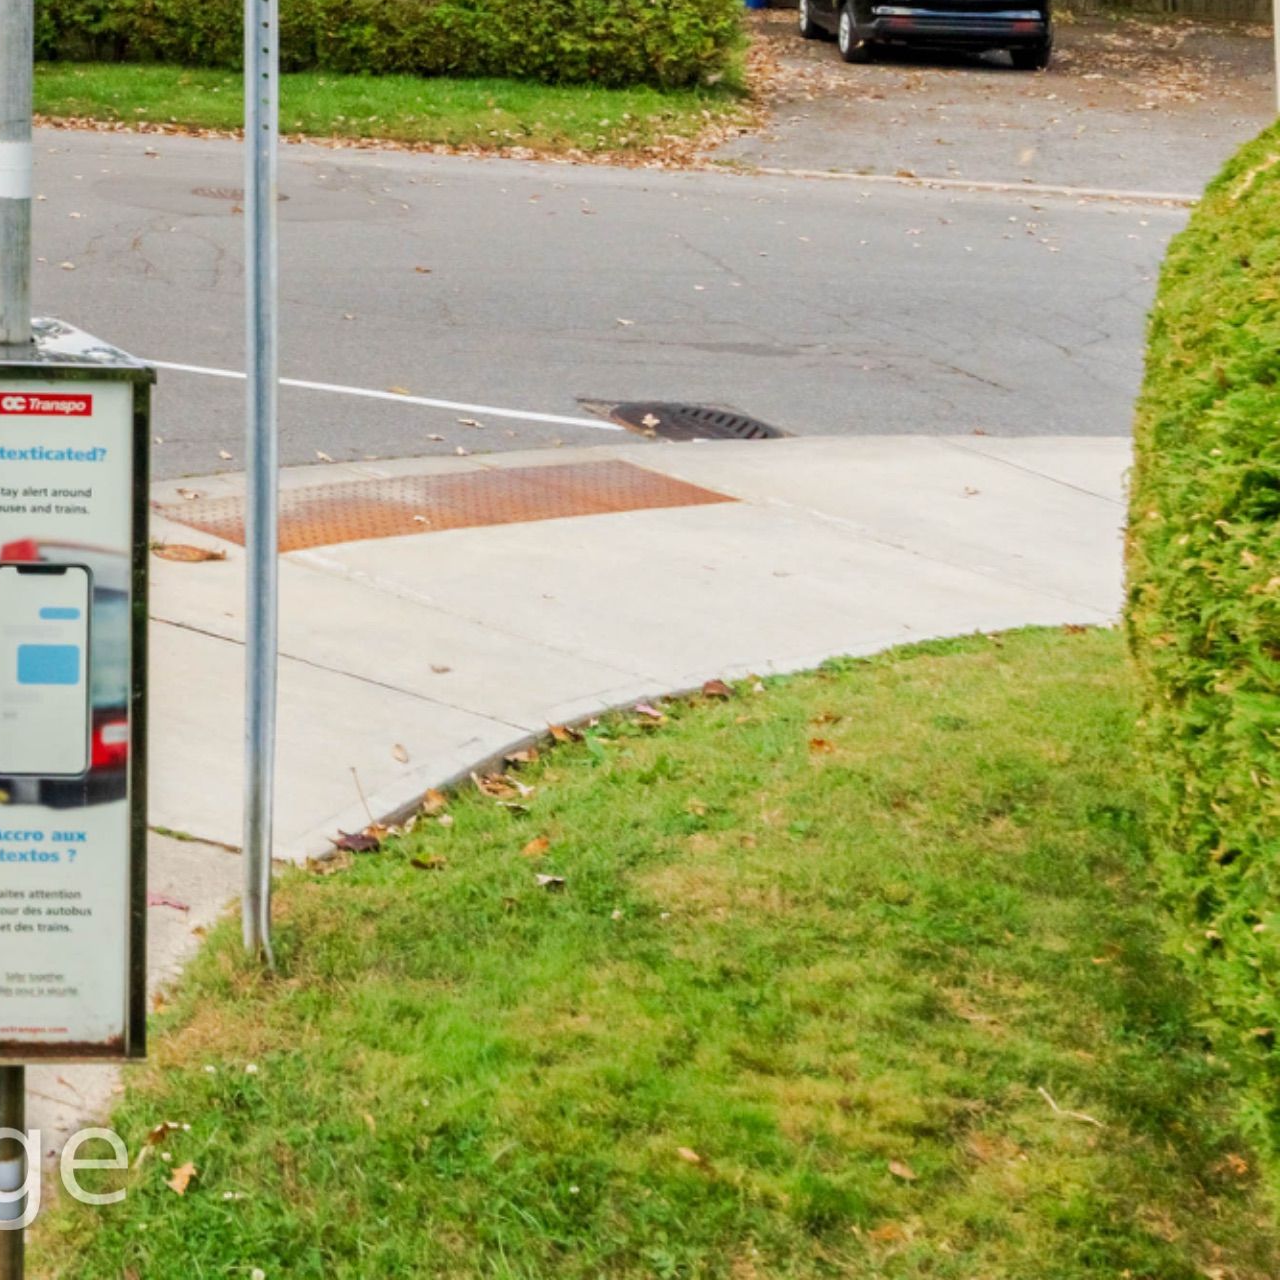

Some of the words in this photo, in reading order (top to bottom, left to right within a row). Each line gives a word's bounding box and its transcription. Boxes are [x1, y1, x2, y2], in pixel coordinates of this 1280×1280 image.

[28, 396, 87, 414] Transpo
[22, 486, 48, 498] alert
[50, 486, 92, 498] around
[30, 502, 52, 514] and
[54, 503, 90, 515] trains.
[51, 829, 88, 843] aux
[28, 888, 82, 900] attention
[22, 904, 43, 917] des
[45, 905, 93, 918] autobus
[0, 921, 12, 933] et
[13, 921, 34, 933] des
[37, 921, 73, 933] trains.
